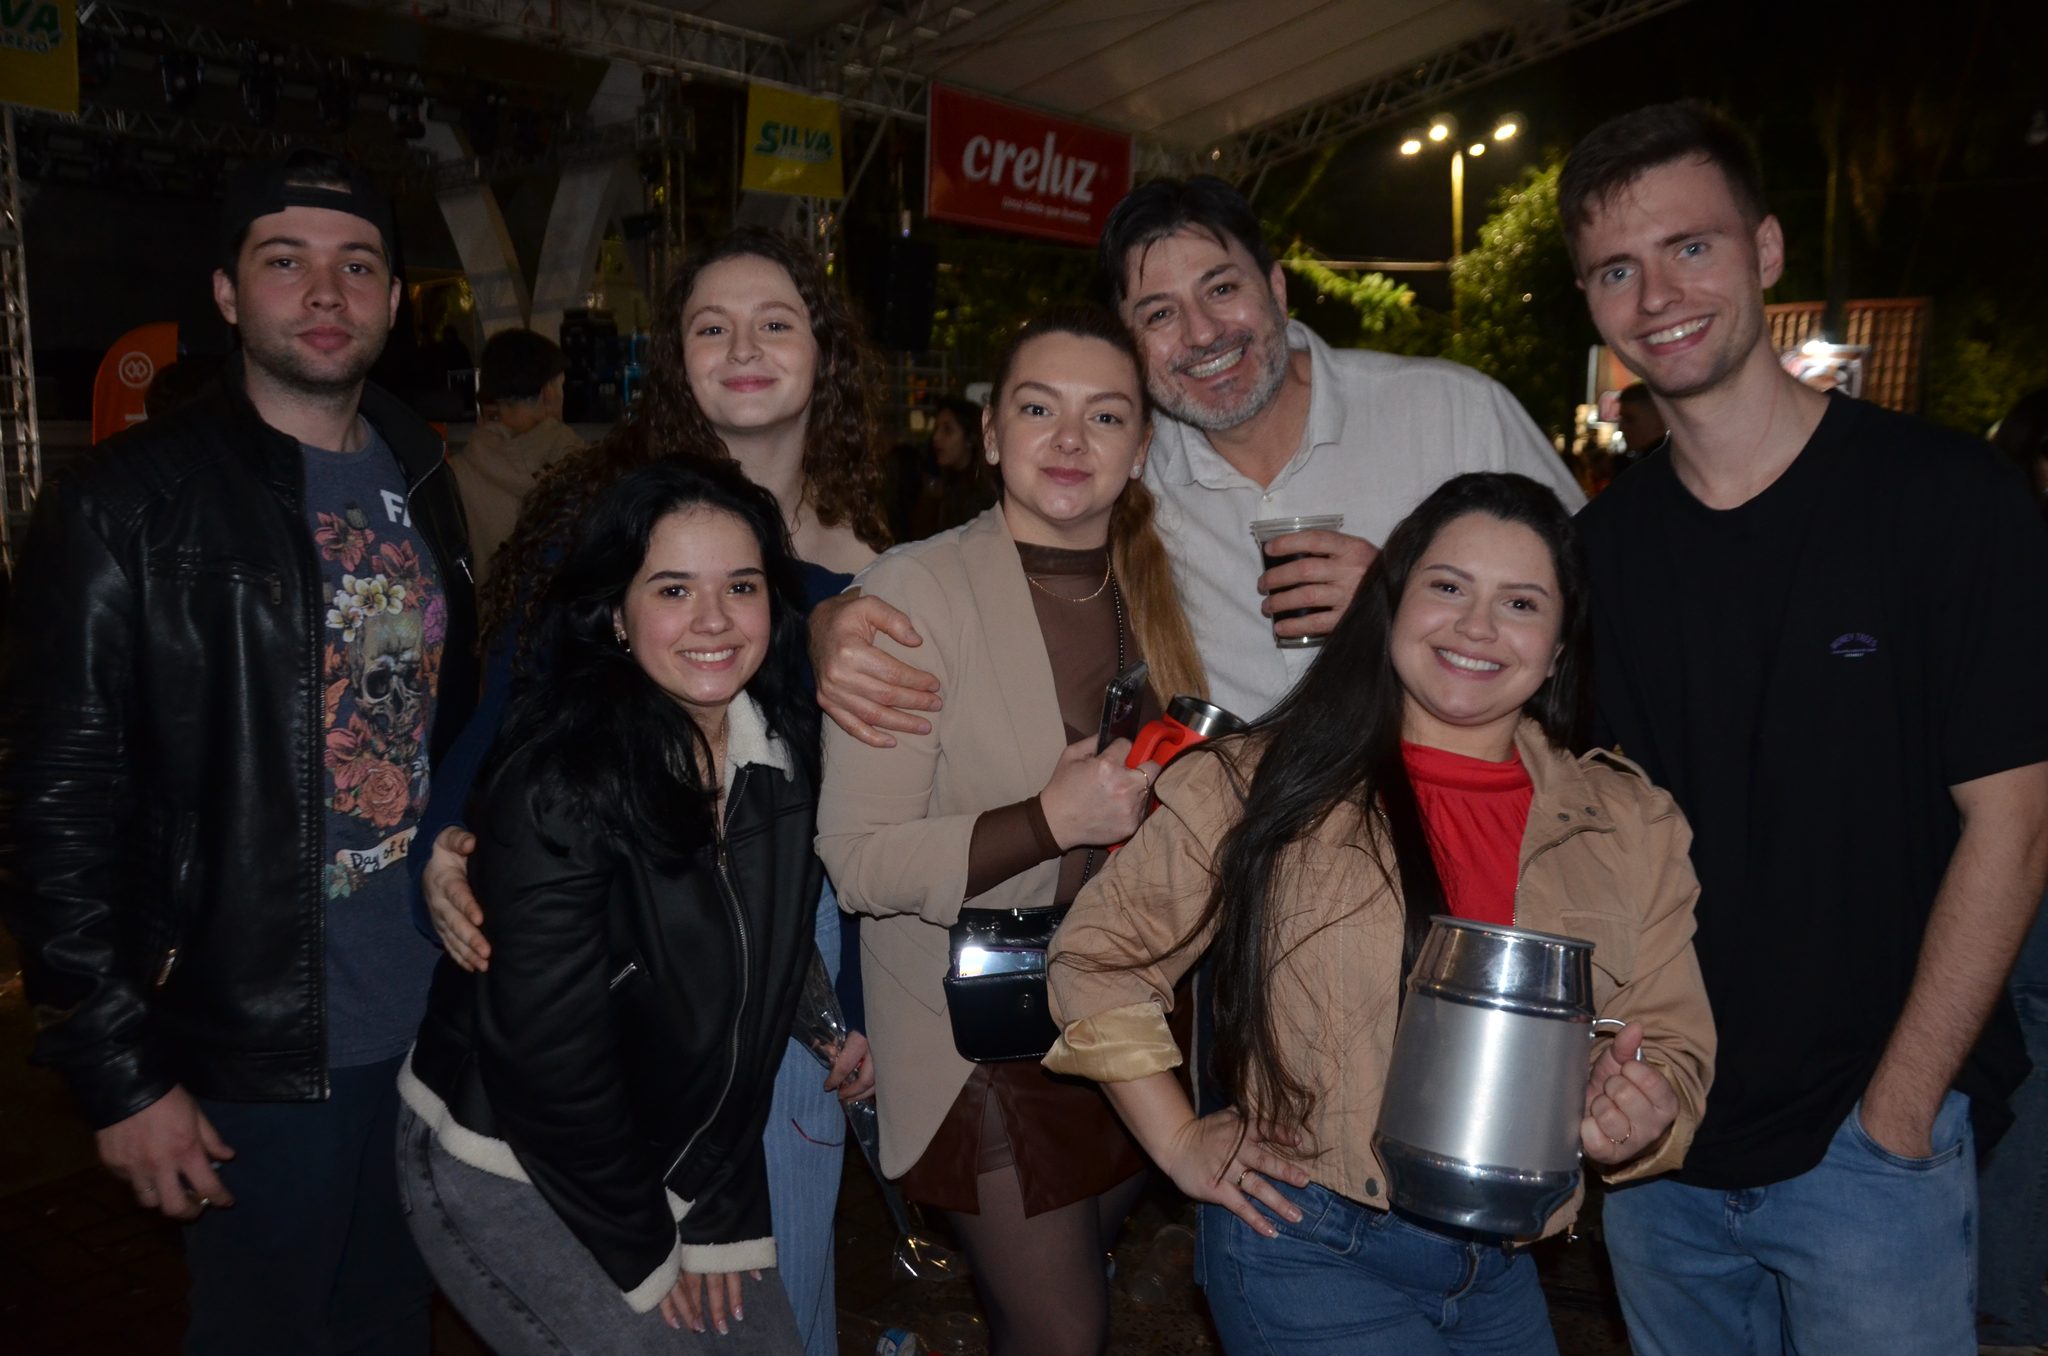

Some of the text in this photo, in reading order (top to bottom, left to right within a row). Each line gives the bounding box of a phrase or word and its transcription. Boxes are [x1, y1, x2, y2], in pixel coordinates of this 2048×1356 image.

[755, 120, 833, 158] SILVA
[961, 130, 1099, 206] creluz
[350, 852, 380, 871] Day
[383, 840, 397, 859] of
